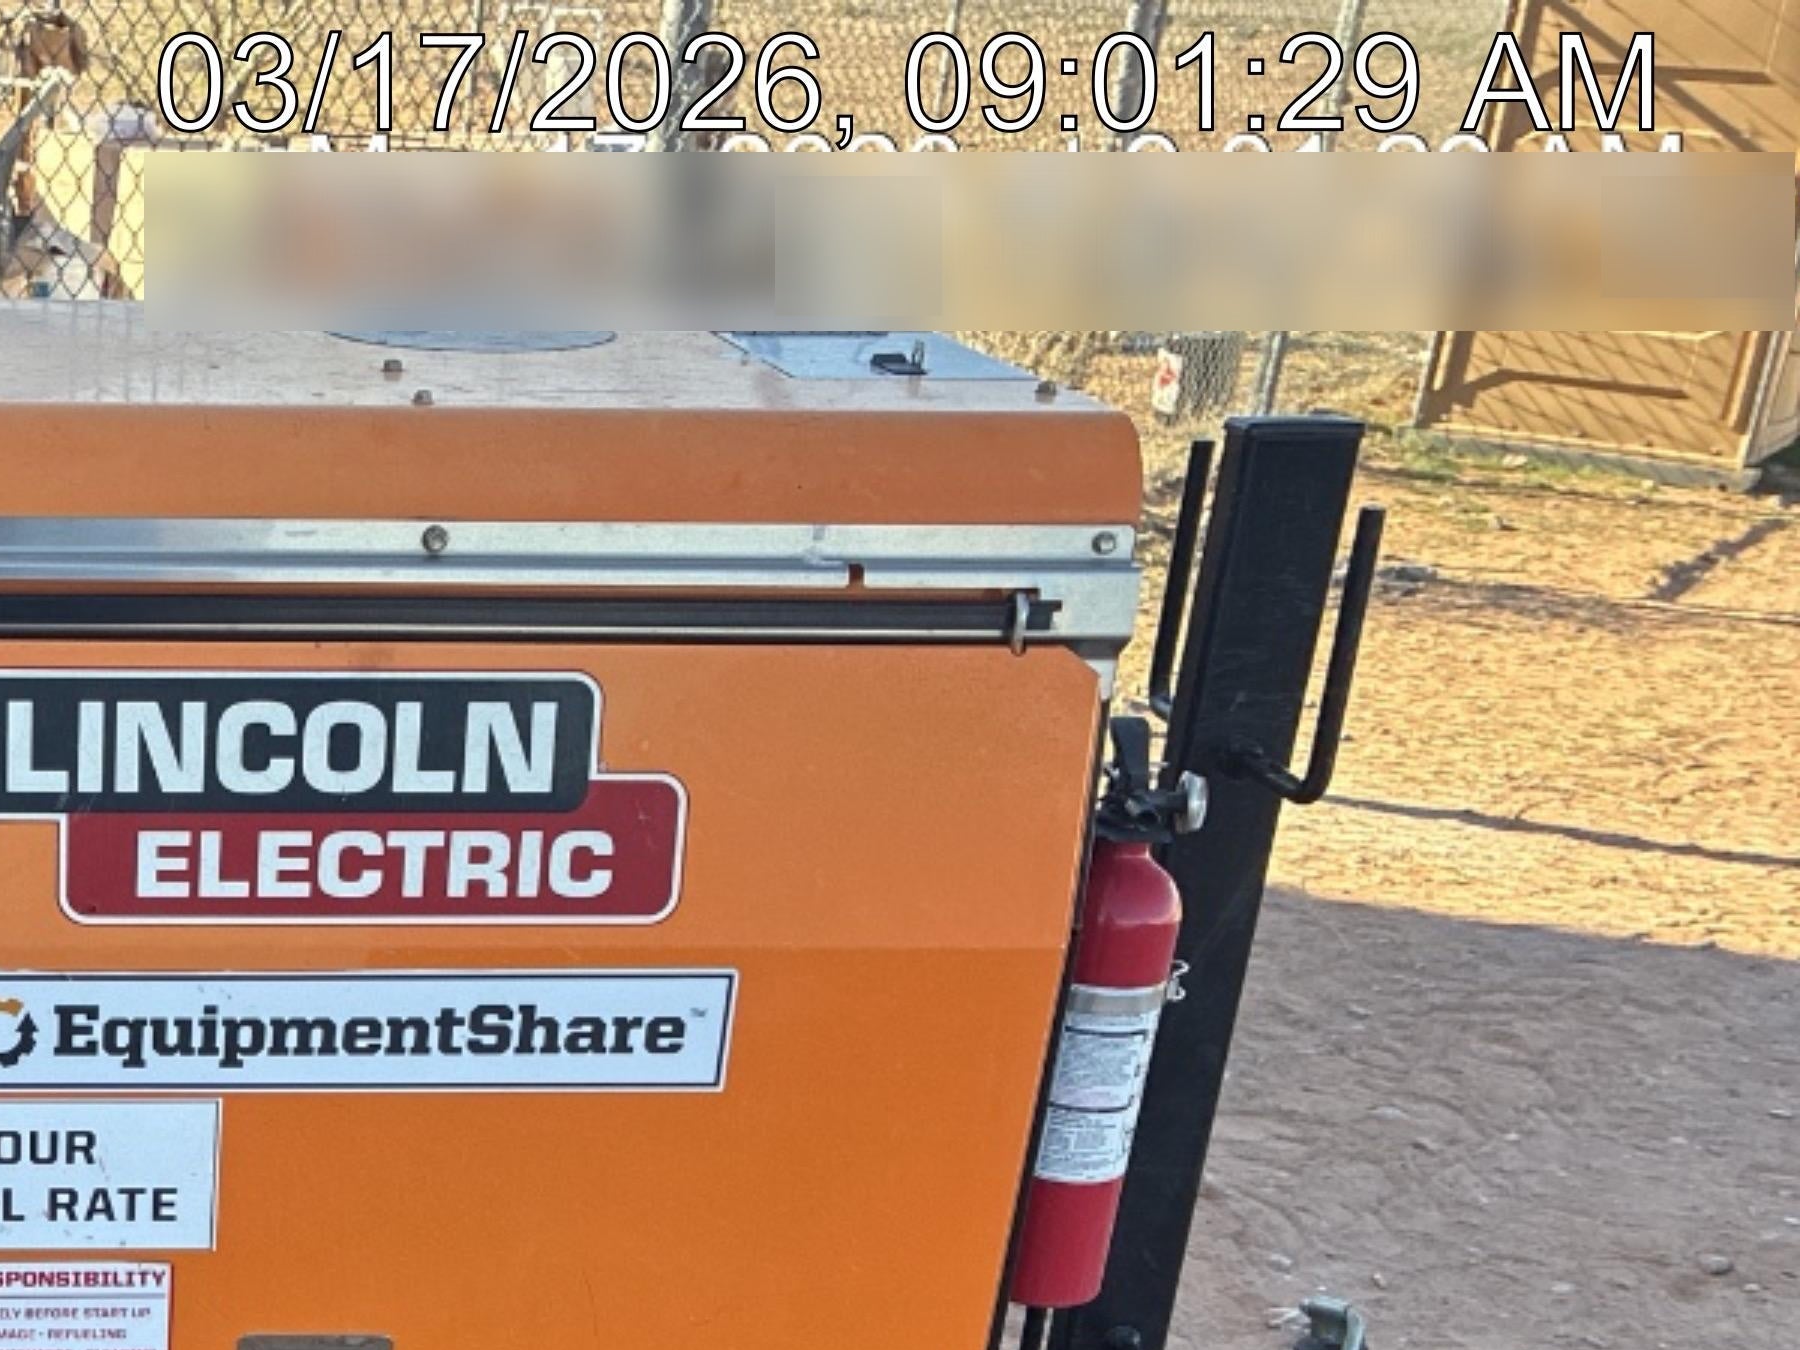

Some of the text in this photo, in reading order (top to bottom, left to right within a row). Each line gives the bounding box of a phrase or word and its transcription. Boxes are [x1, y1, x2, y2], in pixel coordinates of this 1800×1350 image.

[5, 700, 559, 794] LINCOLN
[135, 830, 615, 898] ELECTRIC
[52, 1004, 687, 1069] EquipmentShare
[48, 1187, 179, 1222] RATE
[23, 1307, 78, 1319] BEFORE
[83, 1307, 128, 1319] START
[47, 1327, 127, 1340] REFUELING
